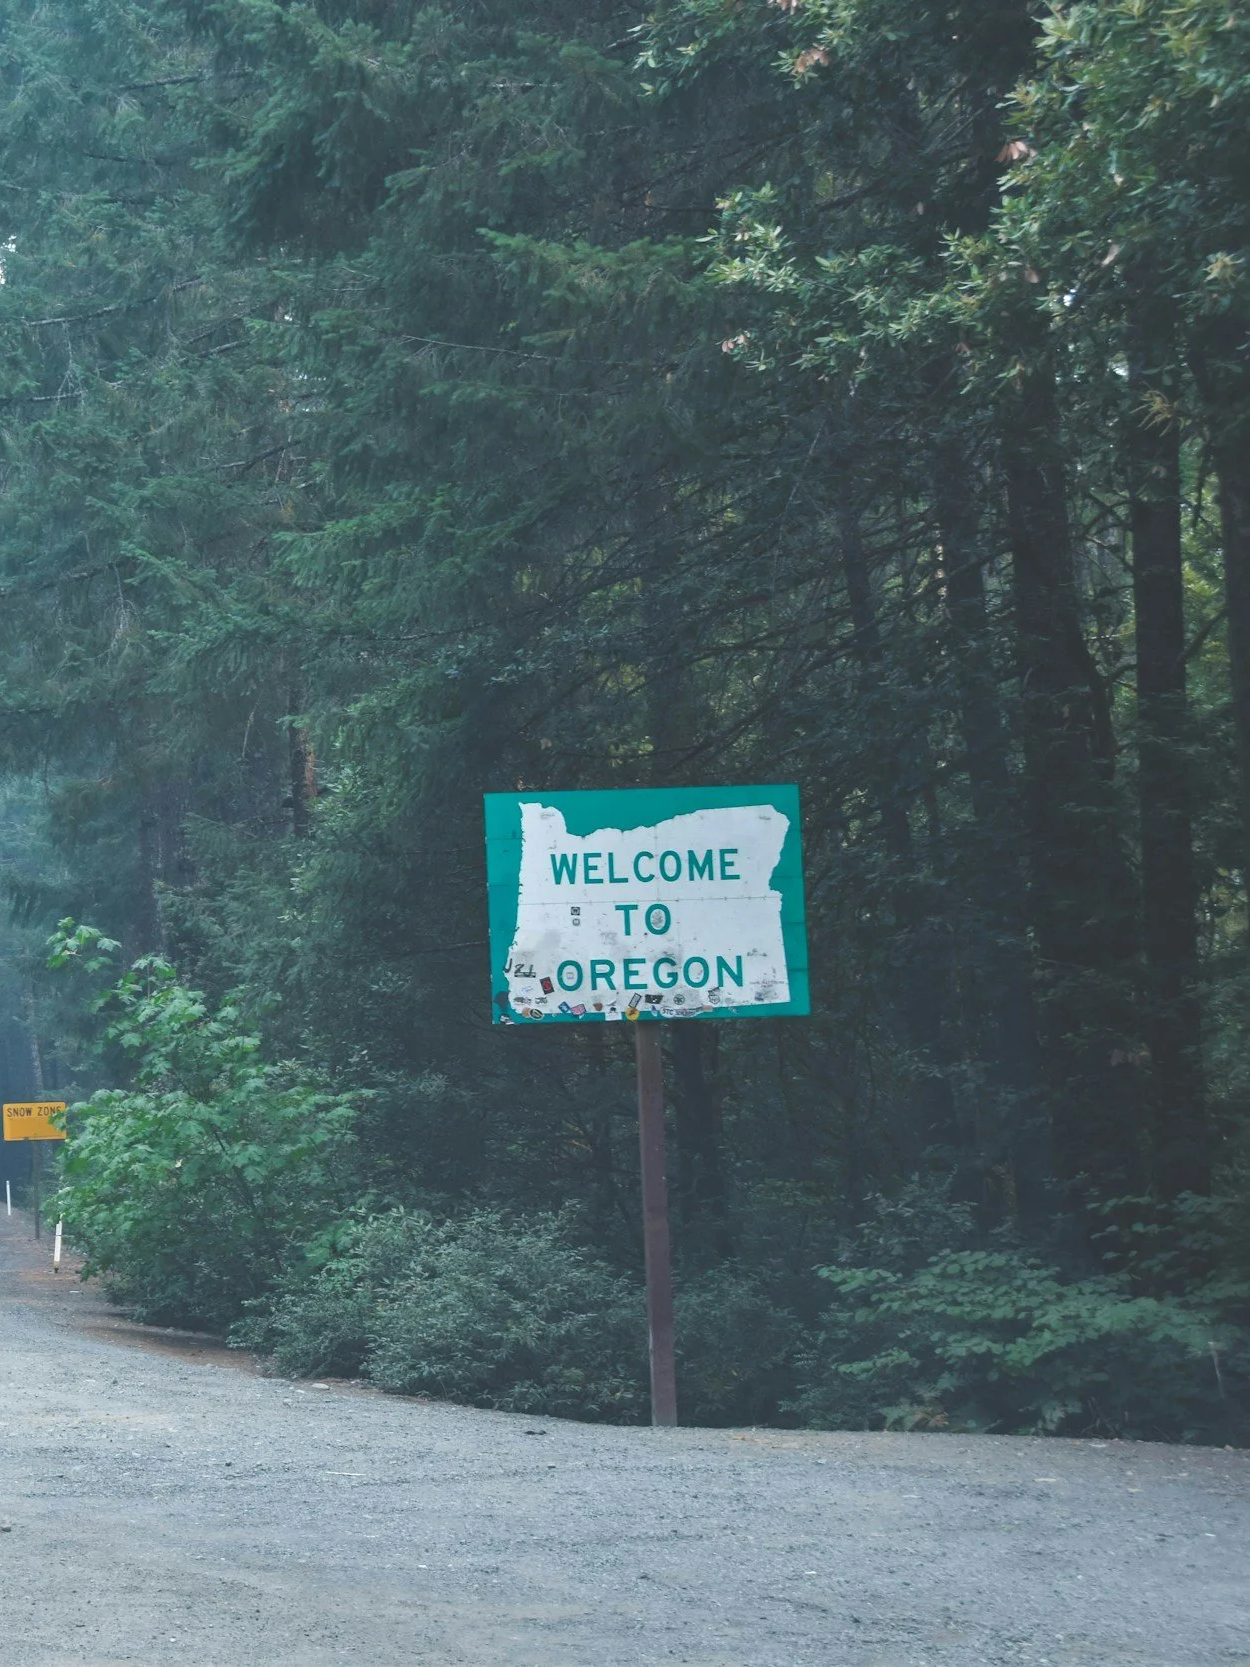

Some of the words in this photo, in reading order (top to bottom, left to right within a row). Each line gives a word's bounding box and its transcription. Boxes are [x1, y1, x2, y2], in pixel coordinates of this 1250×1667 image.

[550, 848, 741, 885] WELCOME
[615, 903, 672, 936] TO
[557, 955, 743, 992] OREGON
[6, 1107, 32, 1118] SNOW
